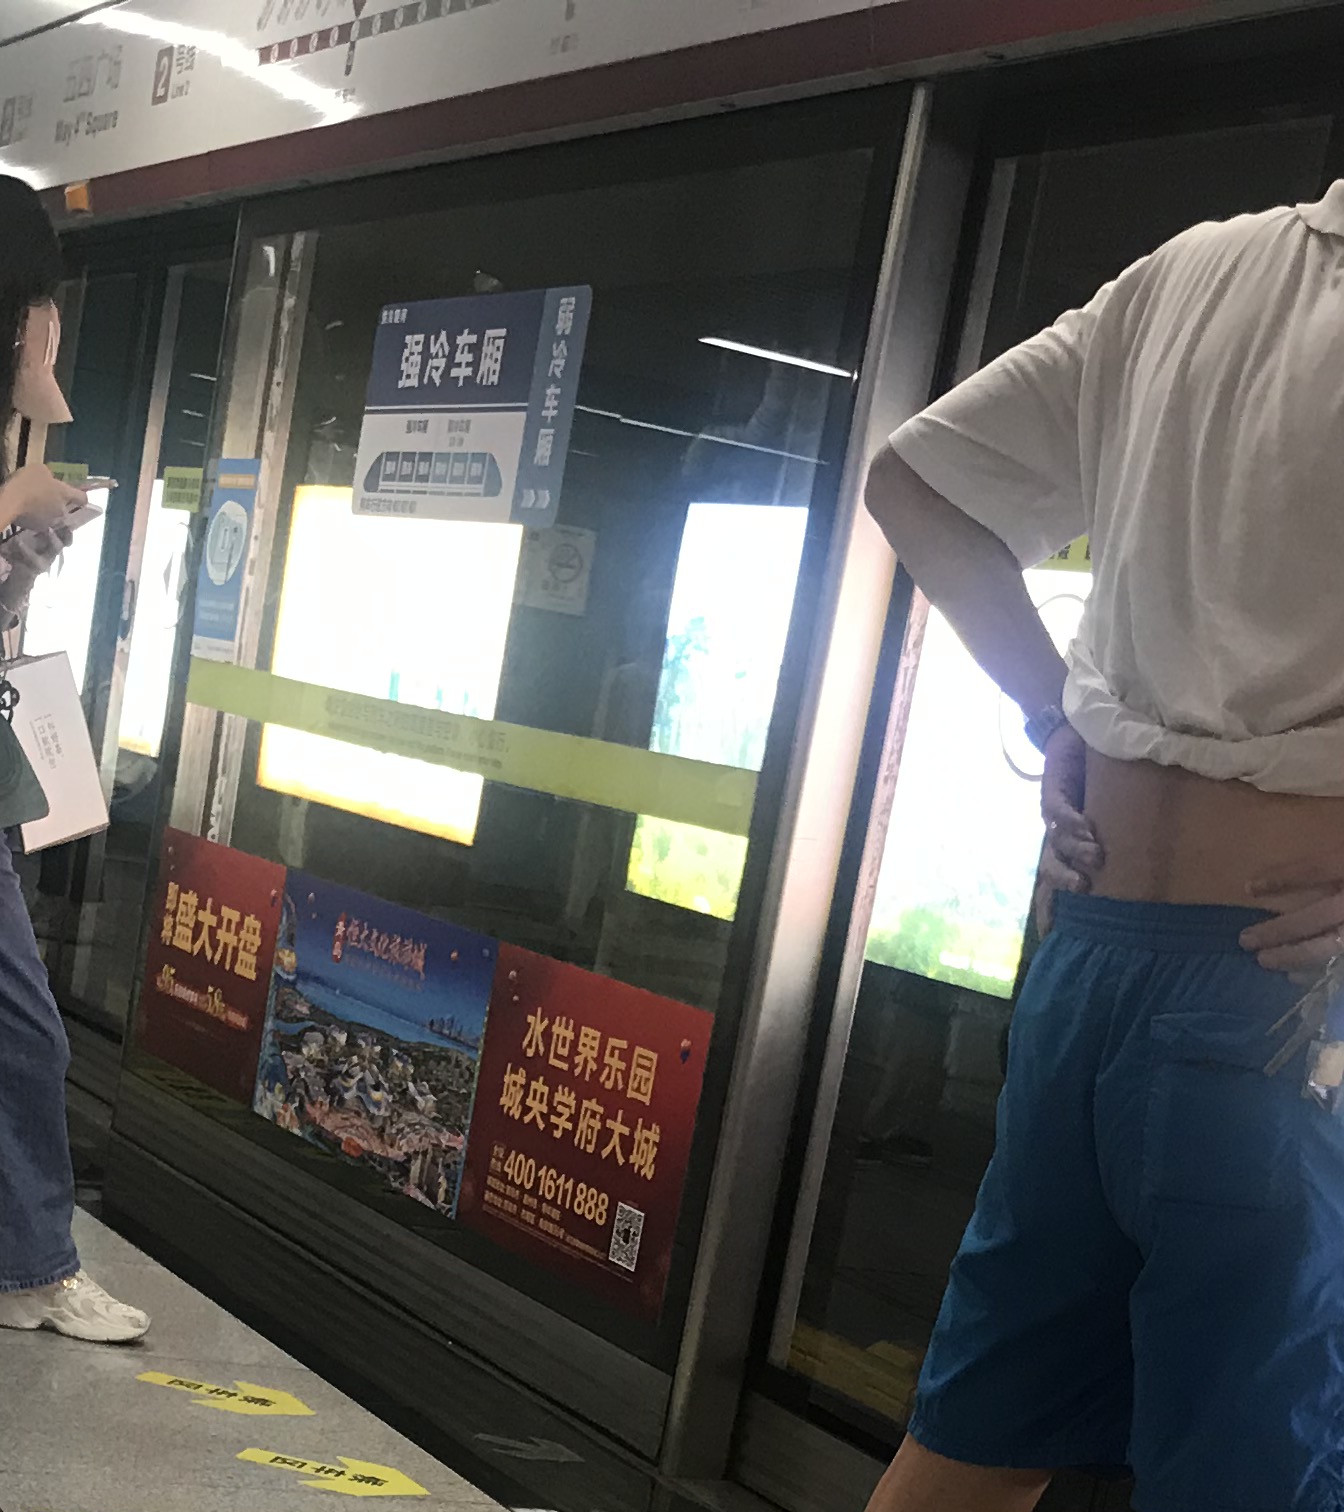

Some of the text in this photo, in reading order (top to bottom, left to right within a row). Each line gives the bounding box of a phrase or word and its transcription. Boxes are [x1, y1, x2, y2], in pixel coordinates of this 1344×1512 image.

[397, 327, 507, 389] 强冷车厢
[533, 296, 576, 467] 弱冷车厢
[172, 889, 262, 982] 盛大开盘
[522, 1006, 658, 1107] 水世界乐园
[499, 1062, 661, 1182] 城央学府大城
[269, 1455, 390, 1488] 候车区
